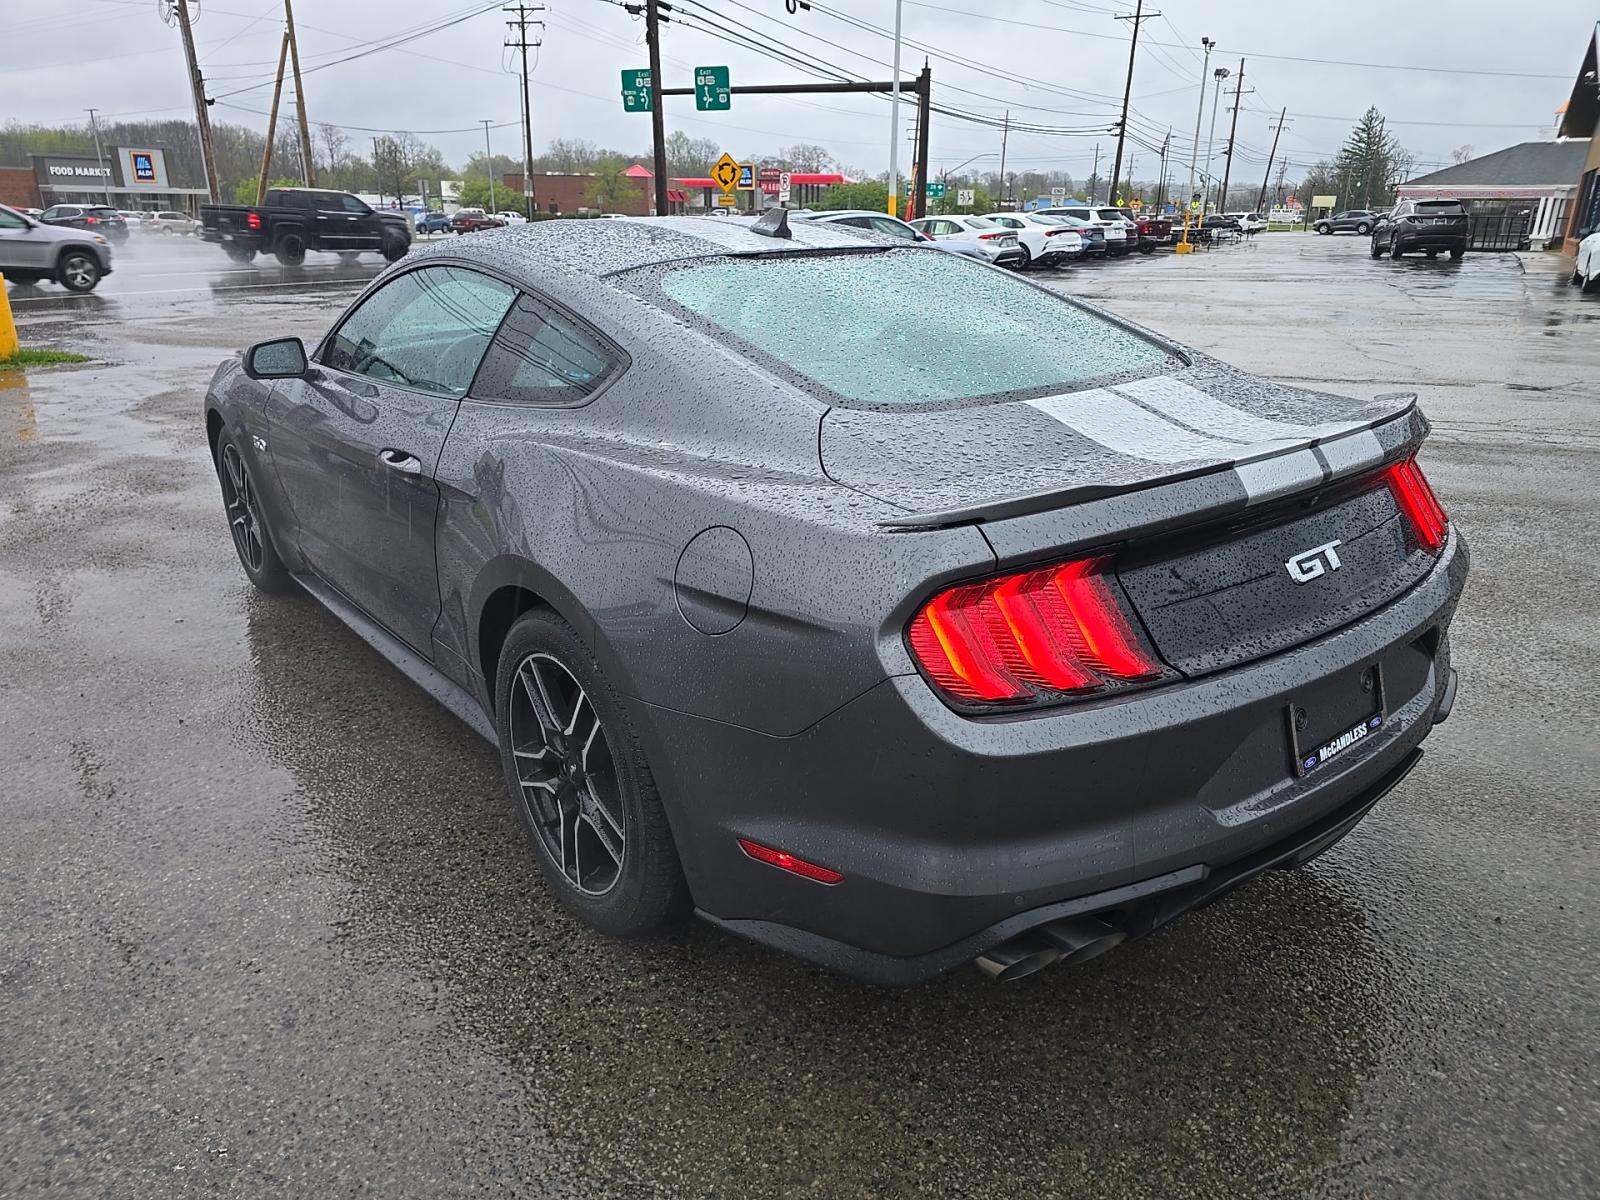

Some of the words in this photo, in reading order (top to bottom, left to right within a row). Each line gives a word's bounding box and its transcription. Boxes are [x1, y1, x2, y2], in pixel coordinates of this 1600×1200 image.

[49, 166, 73, 176] FOOD
[75, 167, 111, 177] MARKET
[1285, 539, 1342, 583] GT
[1319, 722, 1368, 762] McCANDLESS
